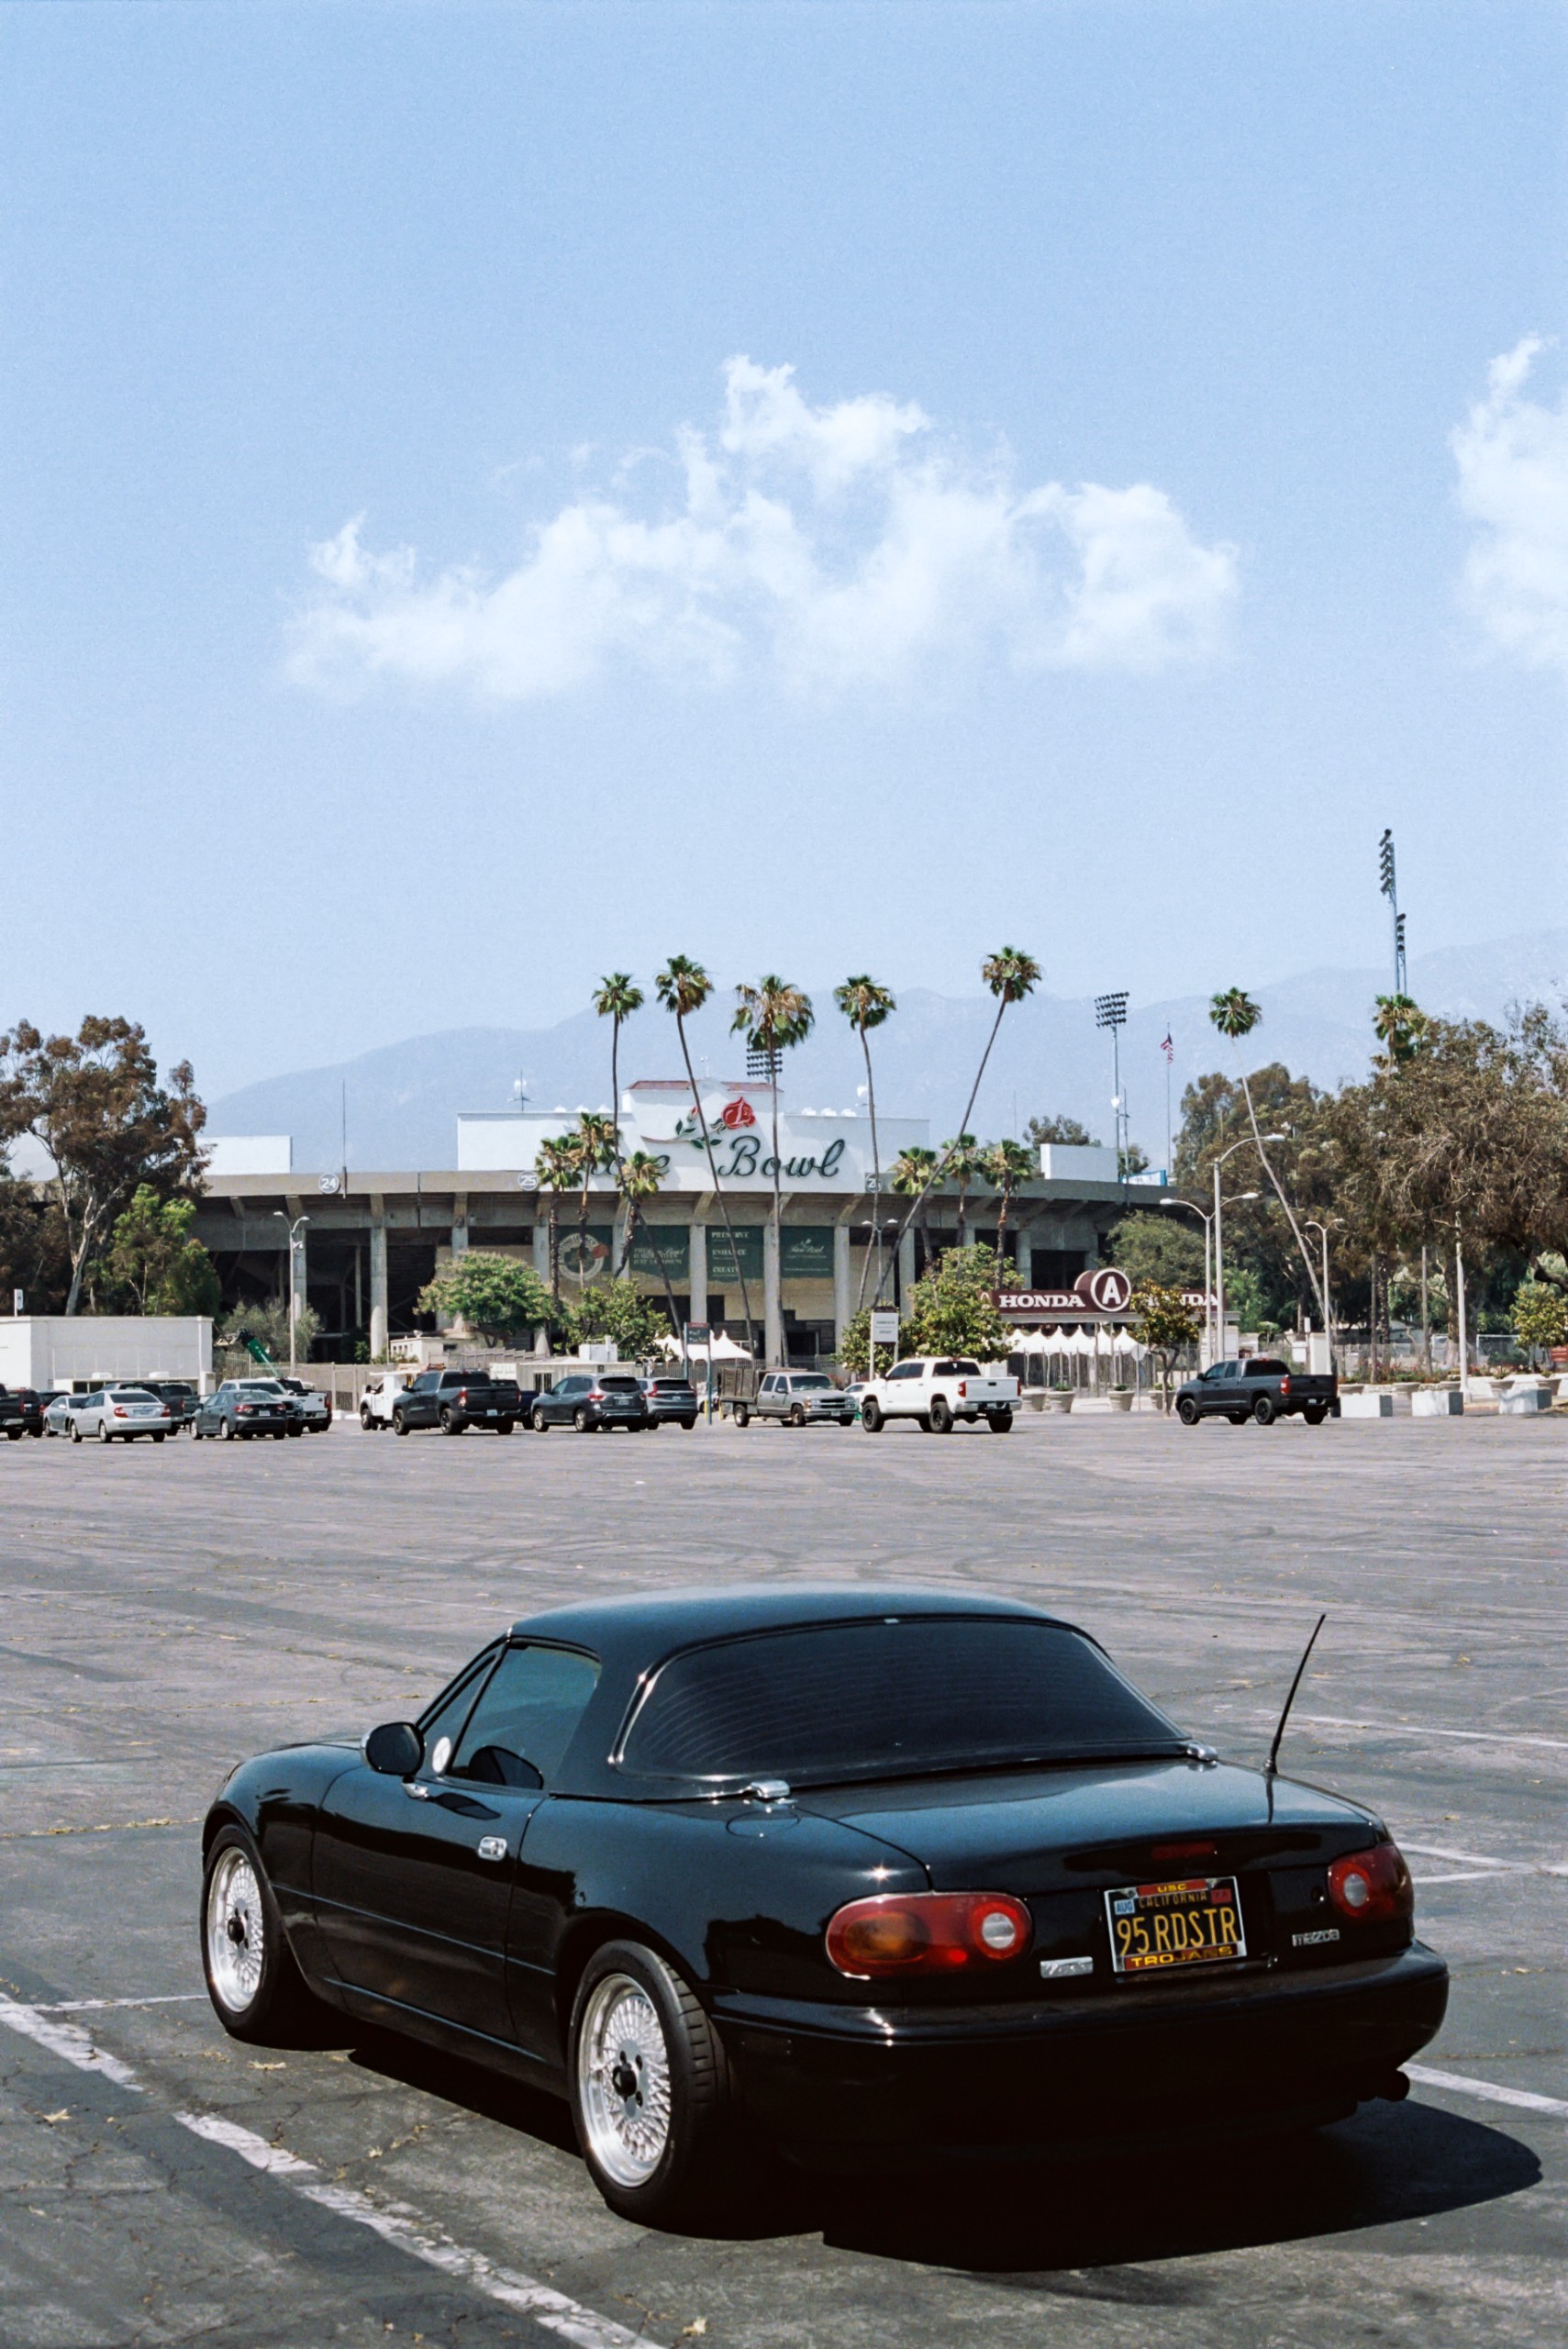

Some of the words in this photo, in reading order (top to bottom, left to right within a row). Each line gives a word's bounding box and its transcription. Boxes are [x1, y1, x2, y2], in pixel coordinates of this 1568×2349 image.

[717, 1136, 845, 1177] Bowl
[321, 1178, 336, 1188] 24
[520, 1174, 537, 1186] 25
[1102, 1276, 1121, 1304] A
[998, 1295, 1086, 1308] HONDA
[1157, 1883, 1188, 1893] USC
[1117, 1900, 1133, 1913] AUG
[1139, 1891, 1207, 1909] CALIFORNIA
[1130, 1945, 1233, 1967] TROJANS
